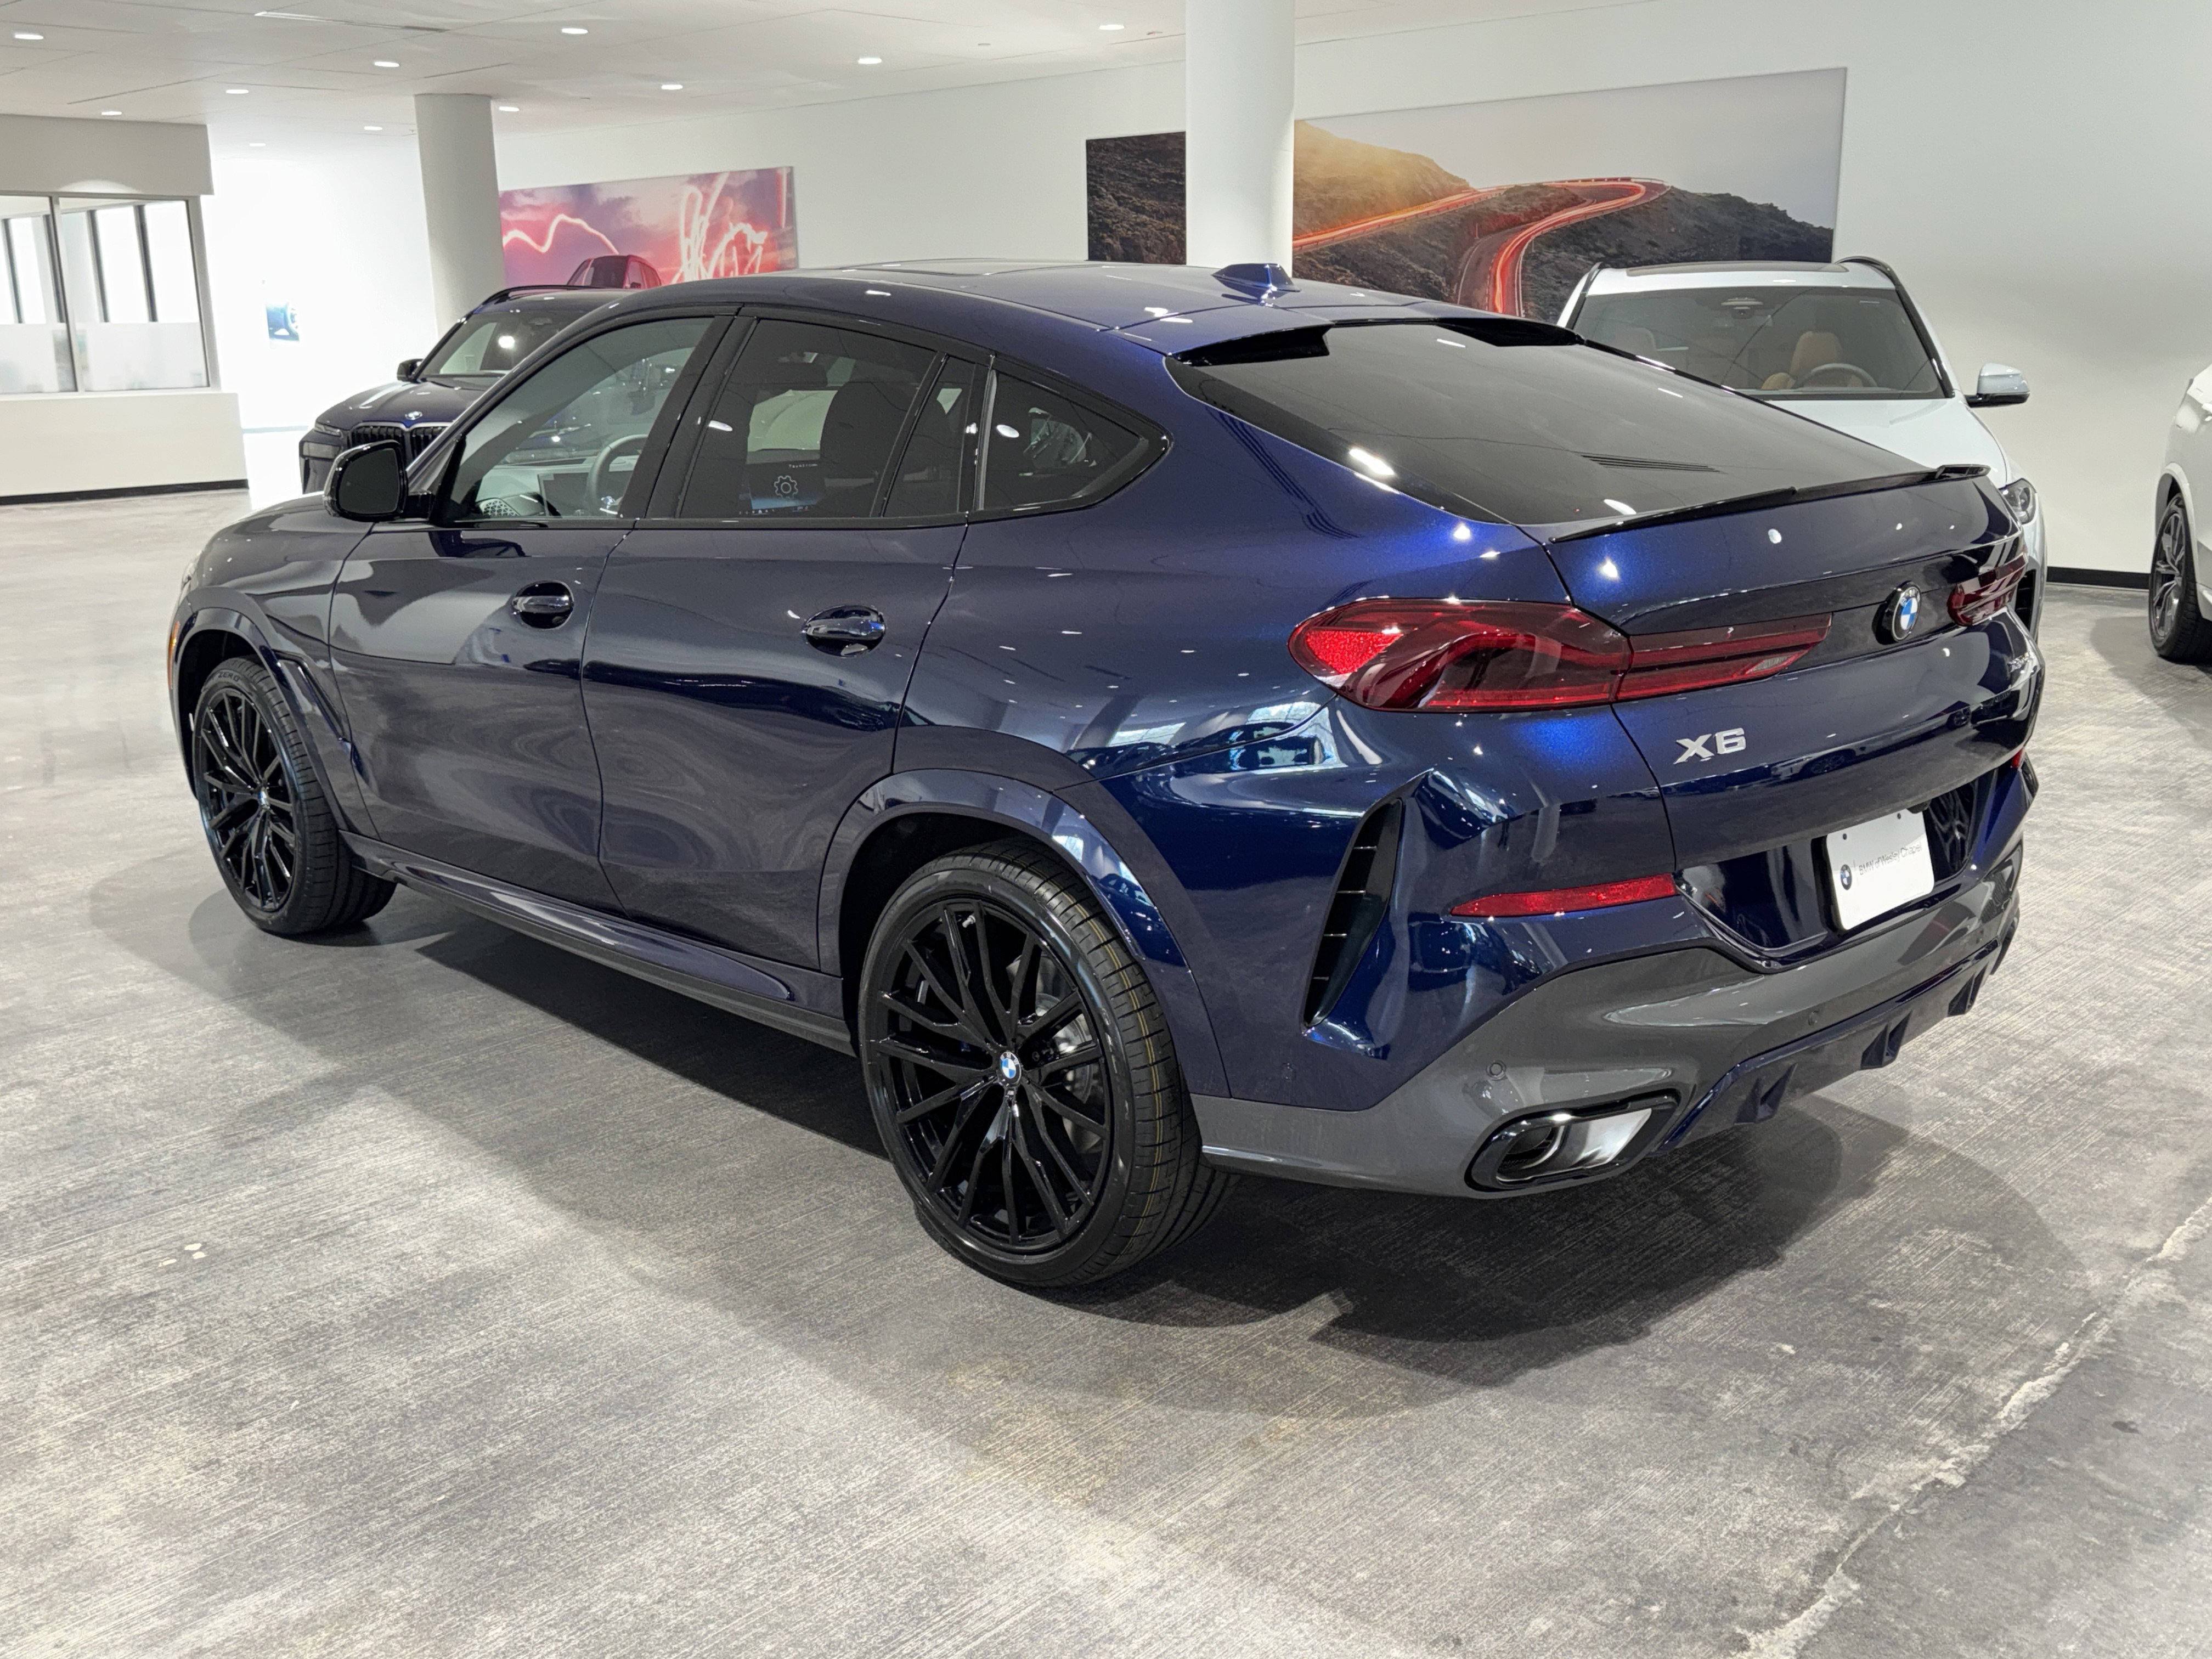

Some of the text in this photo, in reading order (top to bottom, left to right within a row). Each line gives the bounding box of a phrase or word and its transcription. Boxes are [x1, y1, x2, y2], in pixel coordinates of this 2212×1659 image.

[218, 671, 240, 682] ZERO
[1673, 727, 1746, 765] X6
[1858, 860, 1874, 876] BMW
